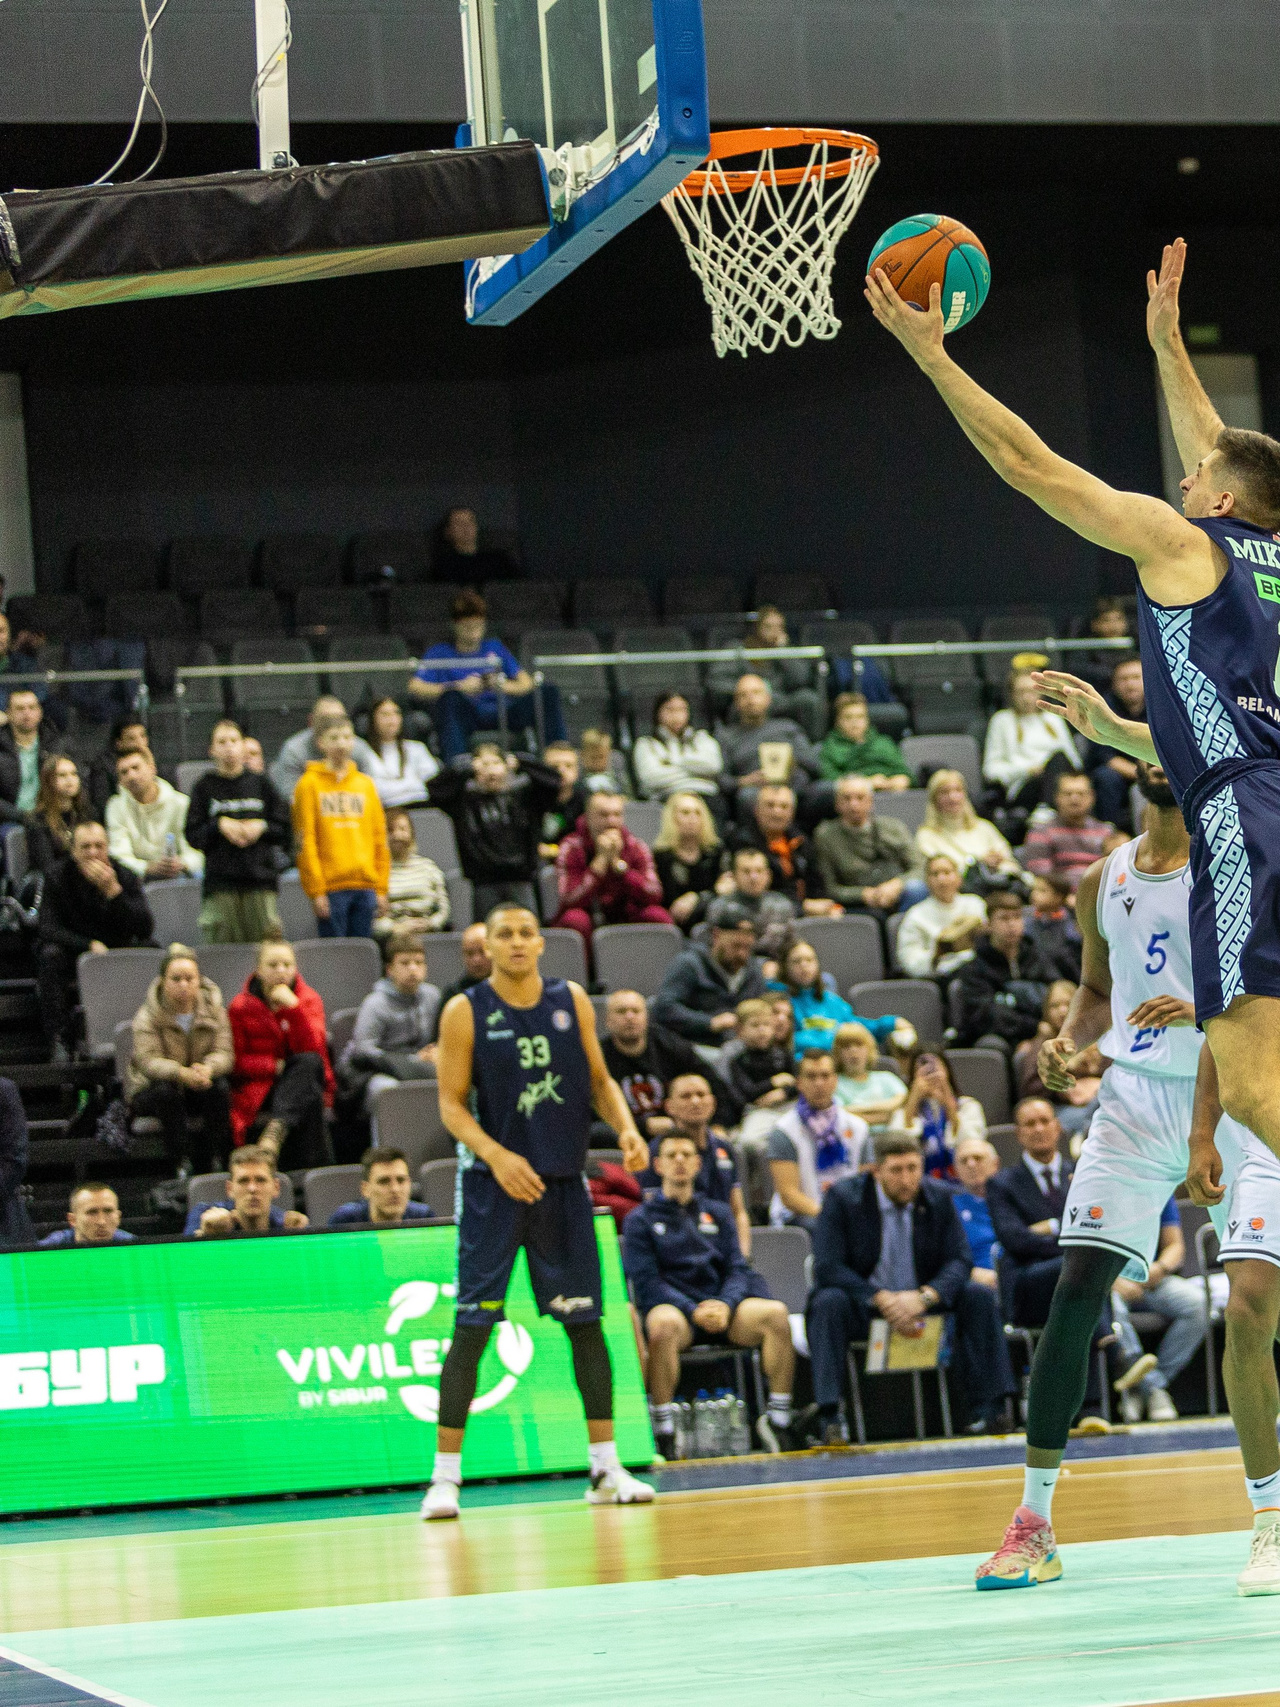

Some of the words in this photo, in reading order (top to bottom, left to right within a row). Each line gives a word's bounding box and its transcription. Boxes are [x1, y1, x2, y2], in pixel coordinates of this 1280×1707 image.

[319, 791, 365, 818] NEW
[1145, 930, 1170, 975] 5
[516, 1034, 552, 1069] 33
[277, 1338, 452, 1384] VIVILE
[298, 1390, 323, 1408] BY
[328, 1386, 388, 1406] SIBUR
